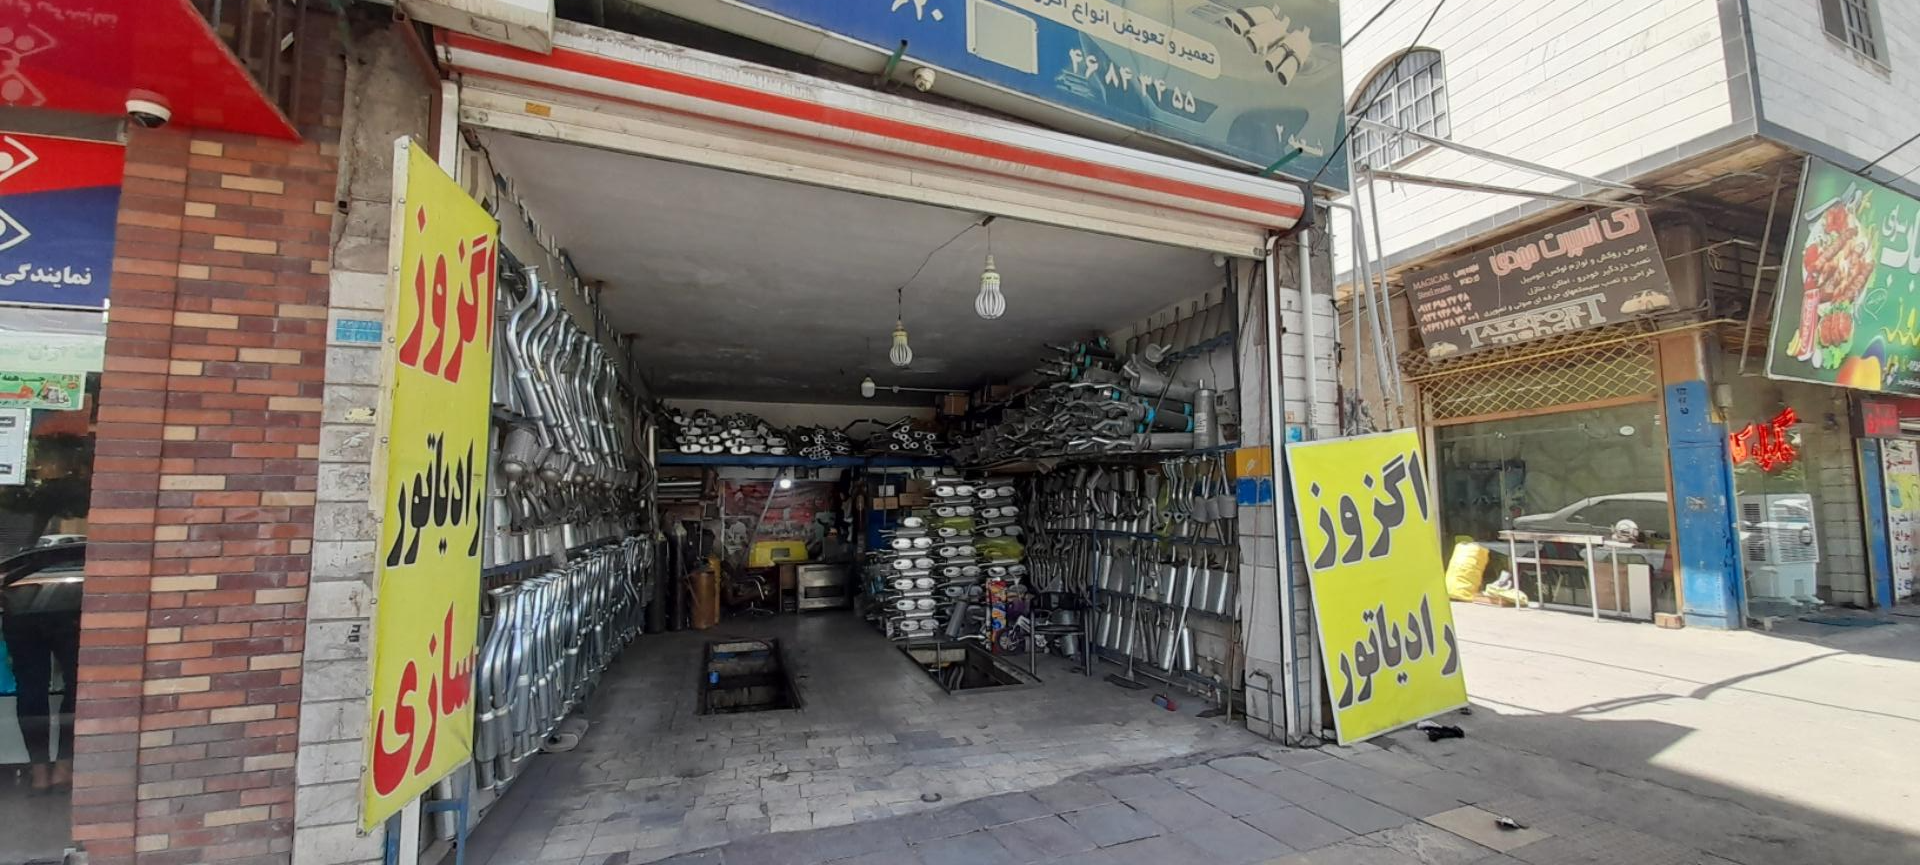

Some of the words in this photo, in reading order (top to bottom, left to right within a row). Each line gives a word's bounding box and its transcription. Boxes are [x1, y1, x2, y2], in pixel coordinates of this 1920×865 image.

[1072, 2, 1109, 25] انواع
[1113, 19, 1165, 45] تعویض
[1168, 41, 1176, 54] و
[1178, 47, 1215, 65] تعمیر
[1069, 48, 1099, 80] ۴۶
[1104, 62, 1133, 91] ۸۴
[1138, 74, 1167, 102] ۳۴
[1172, 86, 1196, 114] ۵۵
[0, 263, 92, 288] نمایندگی
[400, 205, 494, 384] اگزوز
[387, 430, 481, 569] رادیاتور
[1311, 450, 1428, 570] اگزوز
[1337, 593, 1457, 709] رادیاتور
[374, 602, 473, 796] سازی
